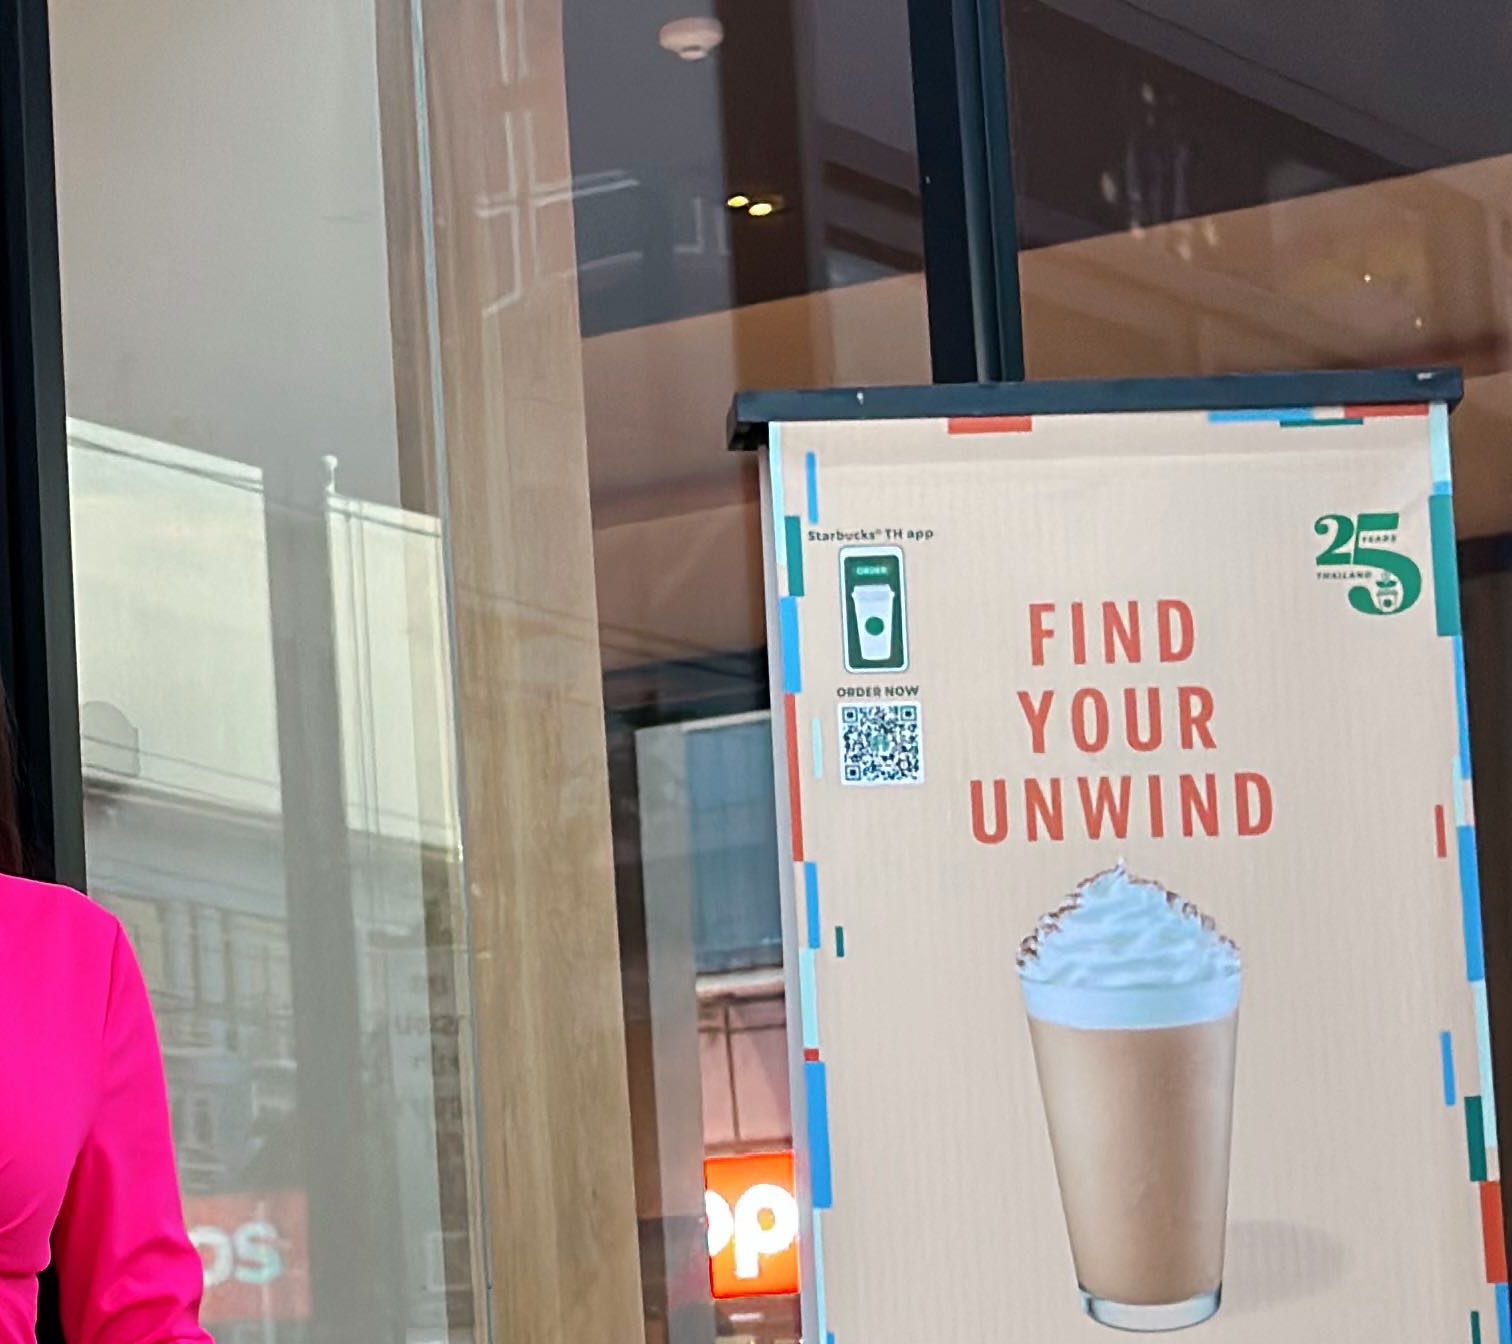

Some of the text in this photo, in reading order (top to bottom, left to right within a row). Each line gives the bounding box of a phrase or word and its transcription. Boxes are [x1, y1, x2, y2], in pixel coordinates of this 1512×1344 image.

[885, 528, 903, 539] TH
[907, 529, 934, 541] app
[1314, 512, 1422, 615] 25
[1316, 571, 1372, 580] THAILAND
[1029, 599, 1195, 666] FIND
[837, 685, 919, 698] ORDER NOW
[1017, 685, 1217, 753] YOUR
[970, 772, 1273, 844] UNWIND
